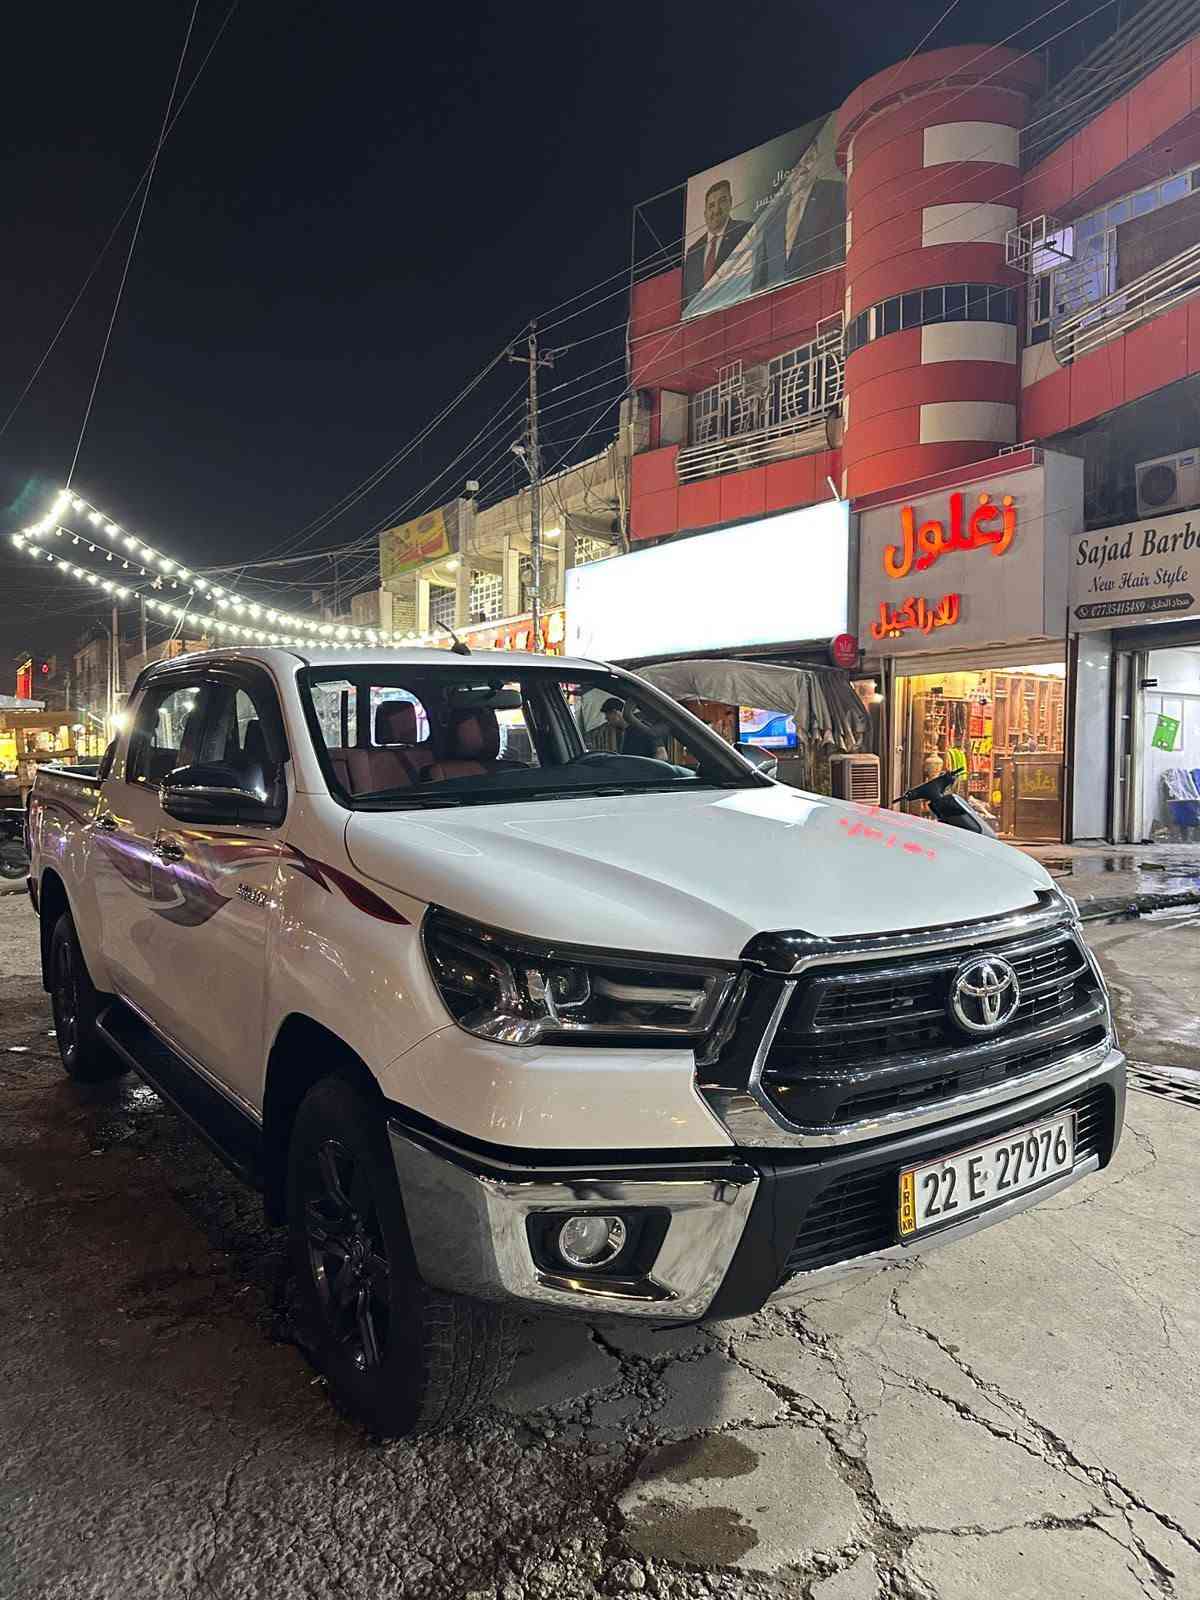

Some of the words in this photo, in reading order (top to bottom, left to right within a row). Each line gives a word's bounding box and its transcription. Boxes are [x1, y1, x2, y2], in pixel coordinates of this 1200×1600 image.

[884, 491, 1016, 578] زغلول
[1076, 531, 1133, 570] Sajad
[1088, 575, 1115, 593] New
[1118, 572, 1151, 590] Hair
[1153, 565, 1189, 590] Style
[924, 1166, 958, 1218] 22
[968, 1155, 986, 1201] E
[995, 1125, 1067, 1191] 27976
